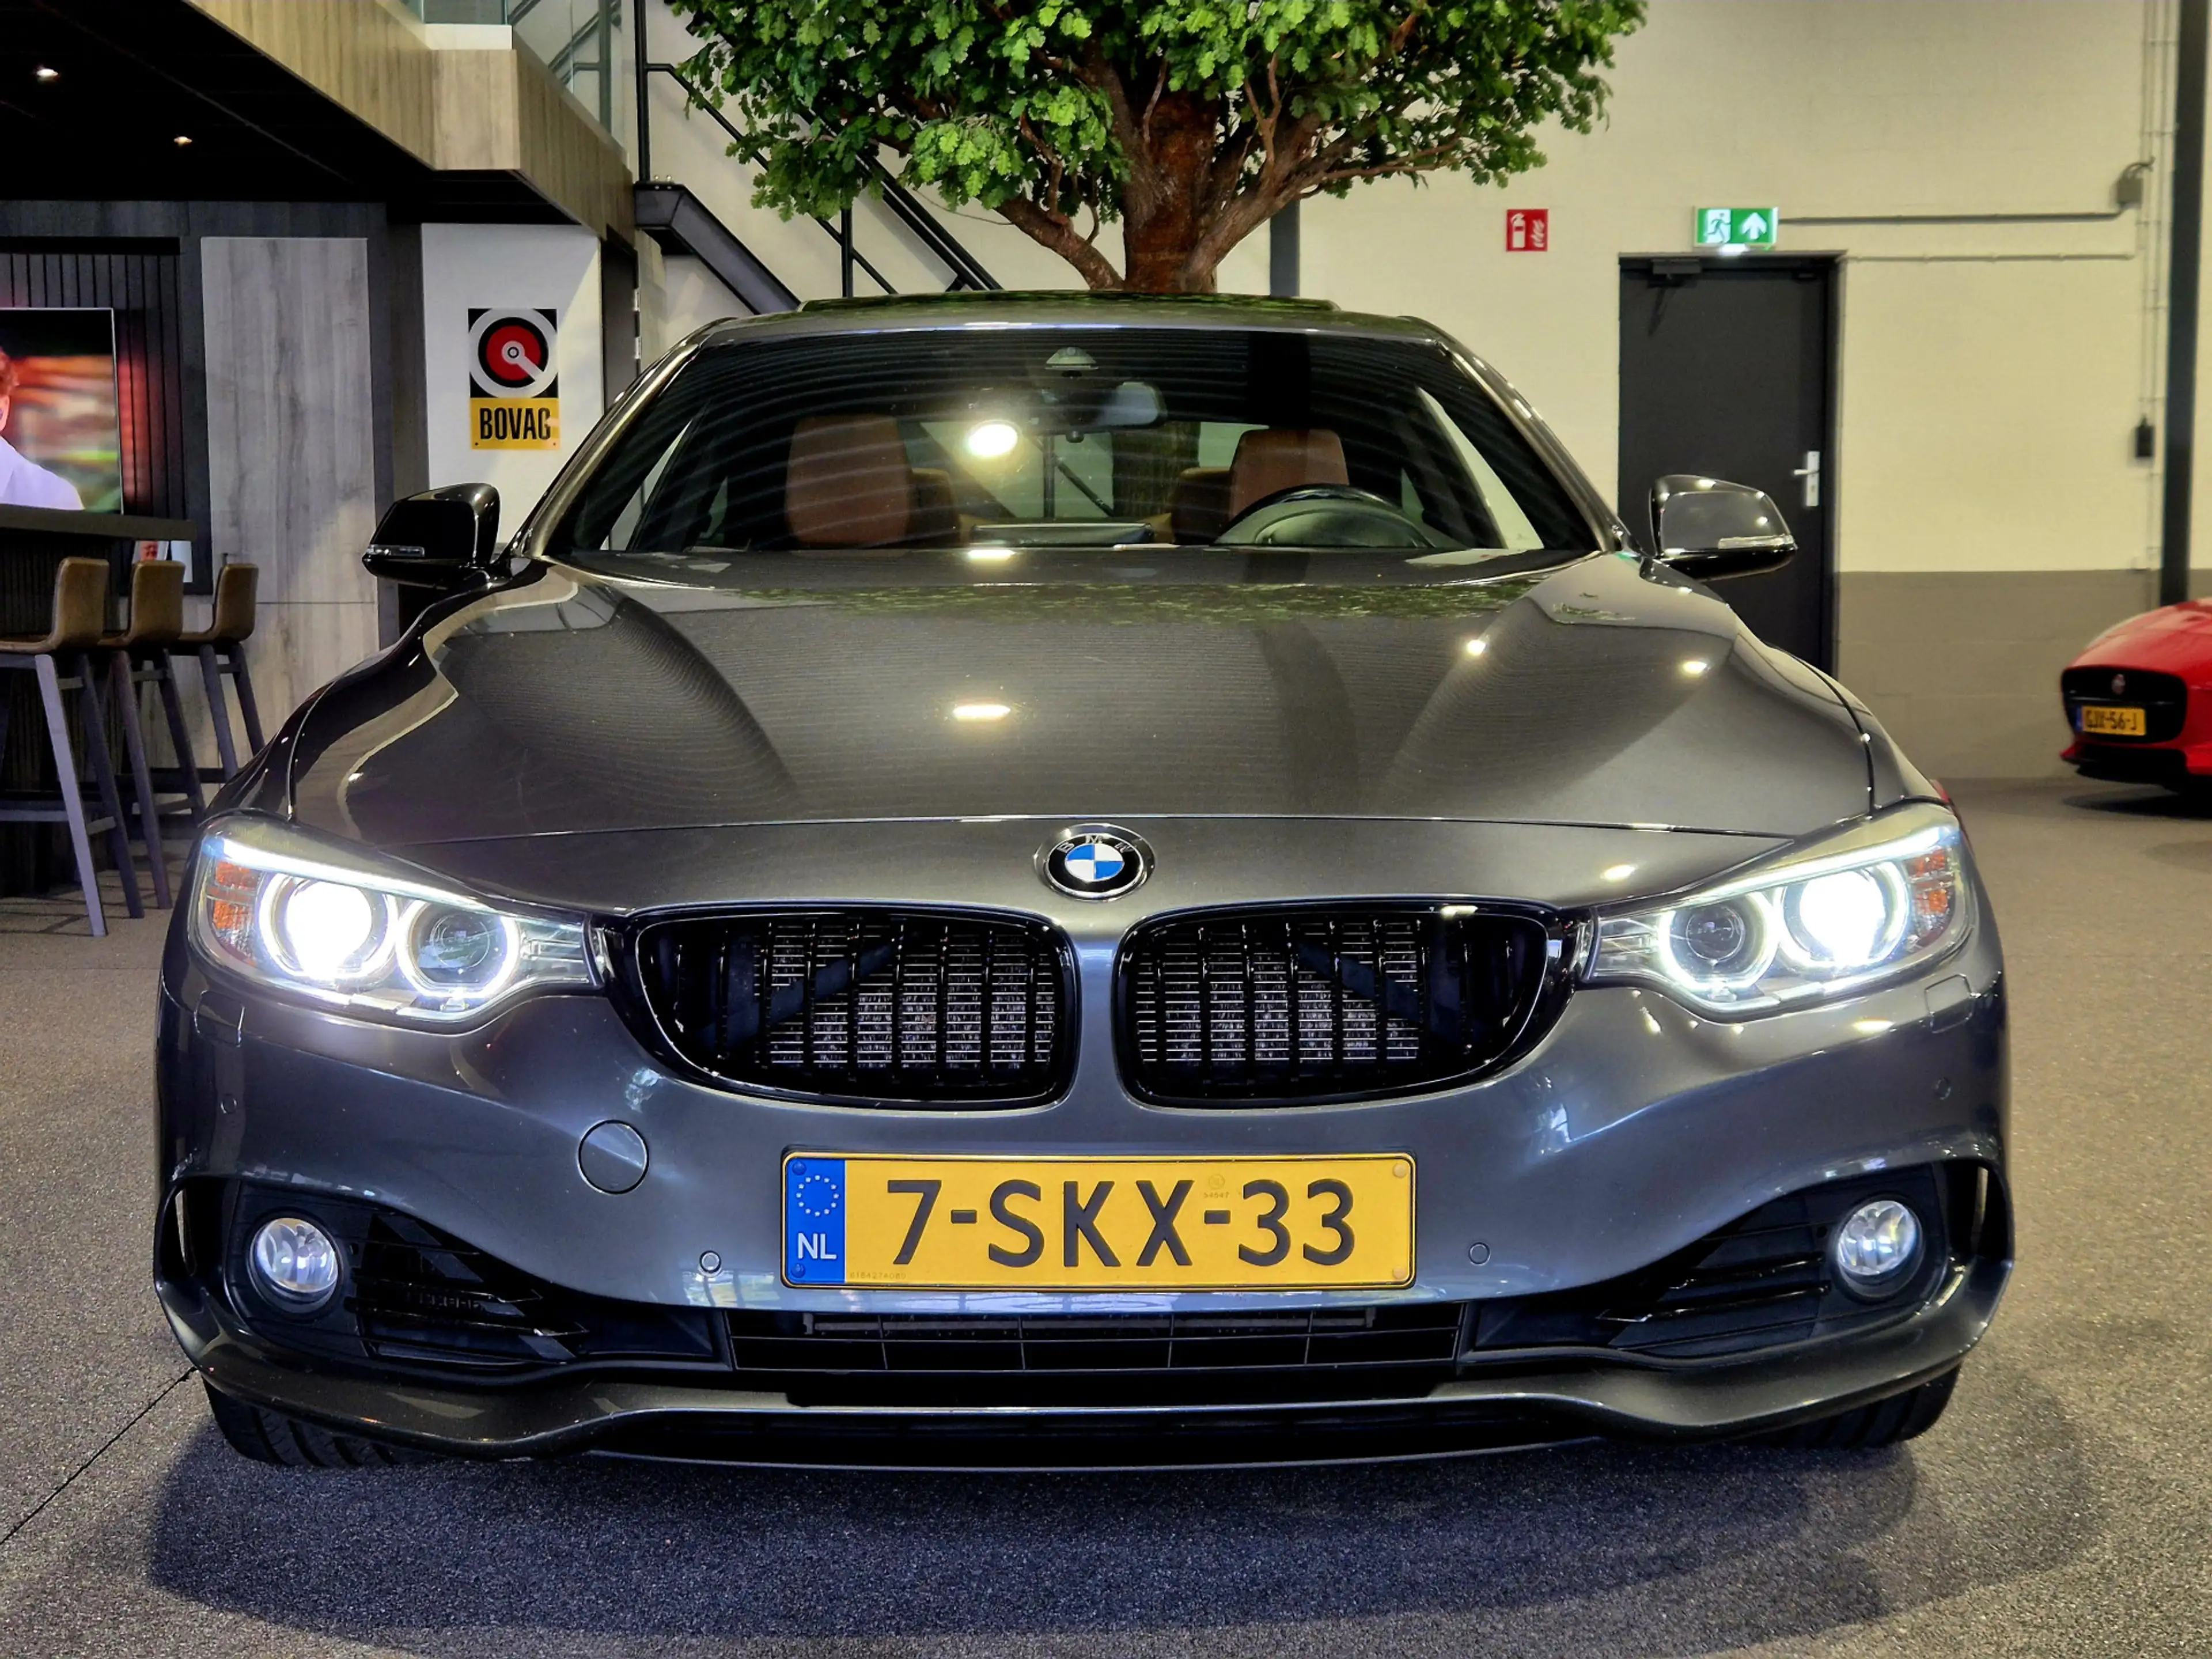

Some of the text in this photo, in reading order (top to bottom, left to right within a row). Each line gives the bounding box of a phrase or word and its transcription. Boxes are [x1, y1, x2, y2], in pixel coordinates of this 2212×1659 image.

[479, 407, 551, 440] BOVAG
[1057, 835, 1135, 853] BMW
[887, 1179, 1355, 1267] 7-SKX-33
[798, 1232, 837, 1260] NL
